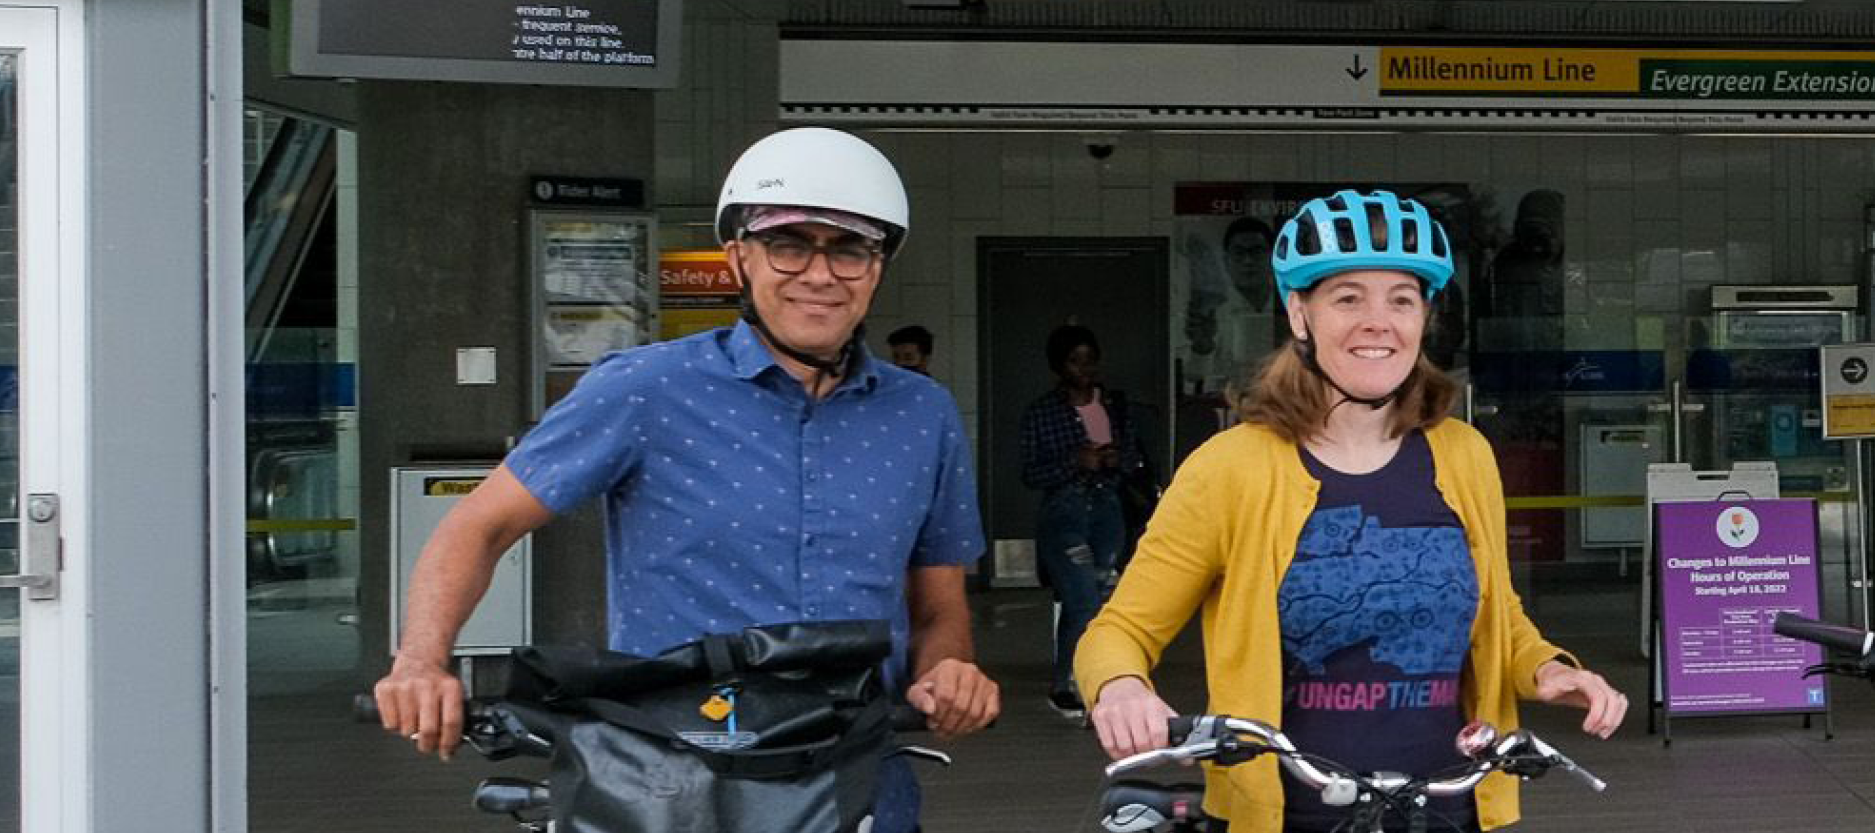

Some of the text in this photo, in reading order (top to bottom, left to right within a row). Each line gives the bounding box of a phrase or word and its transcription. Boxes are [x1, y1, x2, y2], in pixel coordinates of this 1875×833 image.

[1389, 57, 1596, 82] Millennium Line
[1650, 69, 1764, 95] Evergreen
[660, 269, 732, 287] Safety &
[1667, 554, 1811, 570] Changes to Millennium Line
[1690, 570, 1789, 583] Hours of Operation
[1695, 586, 1727, 597] Starting
[1728, 585, 1748, 596] April
